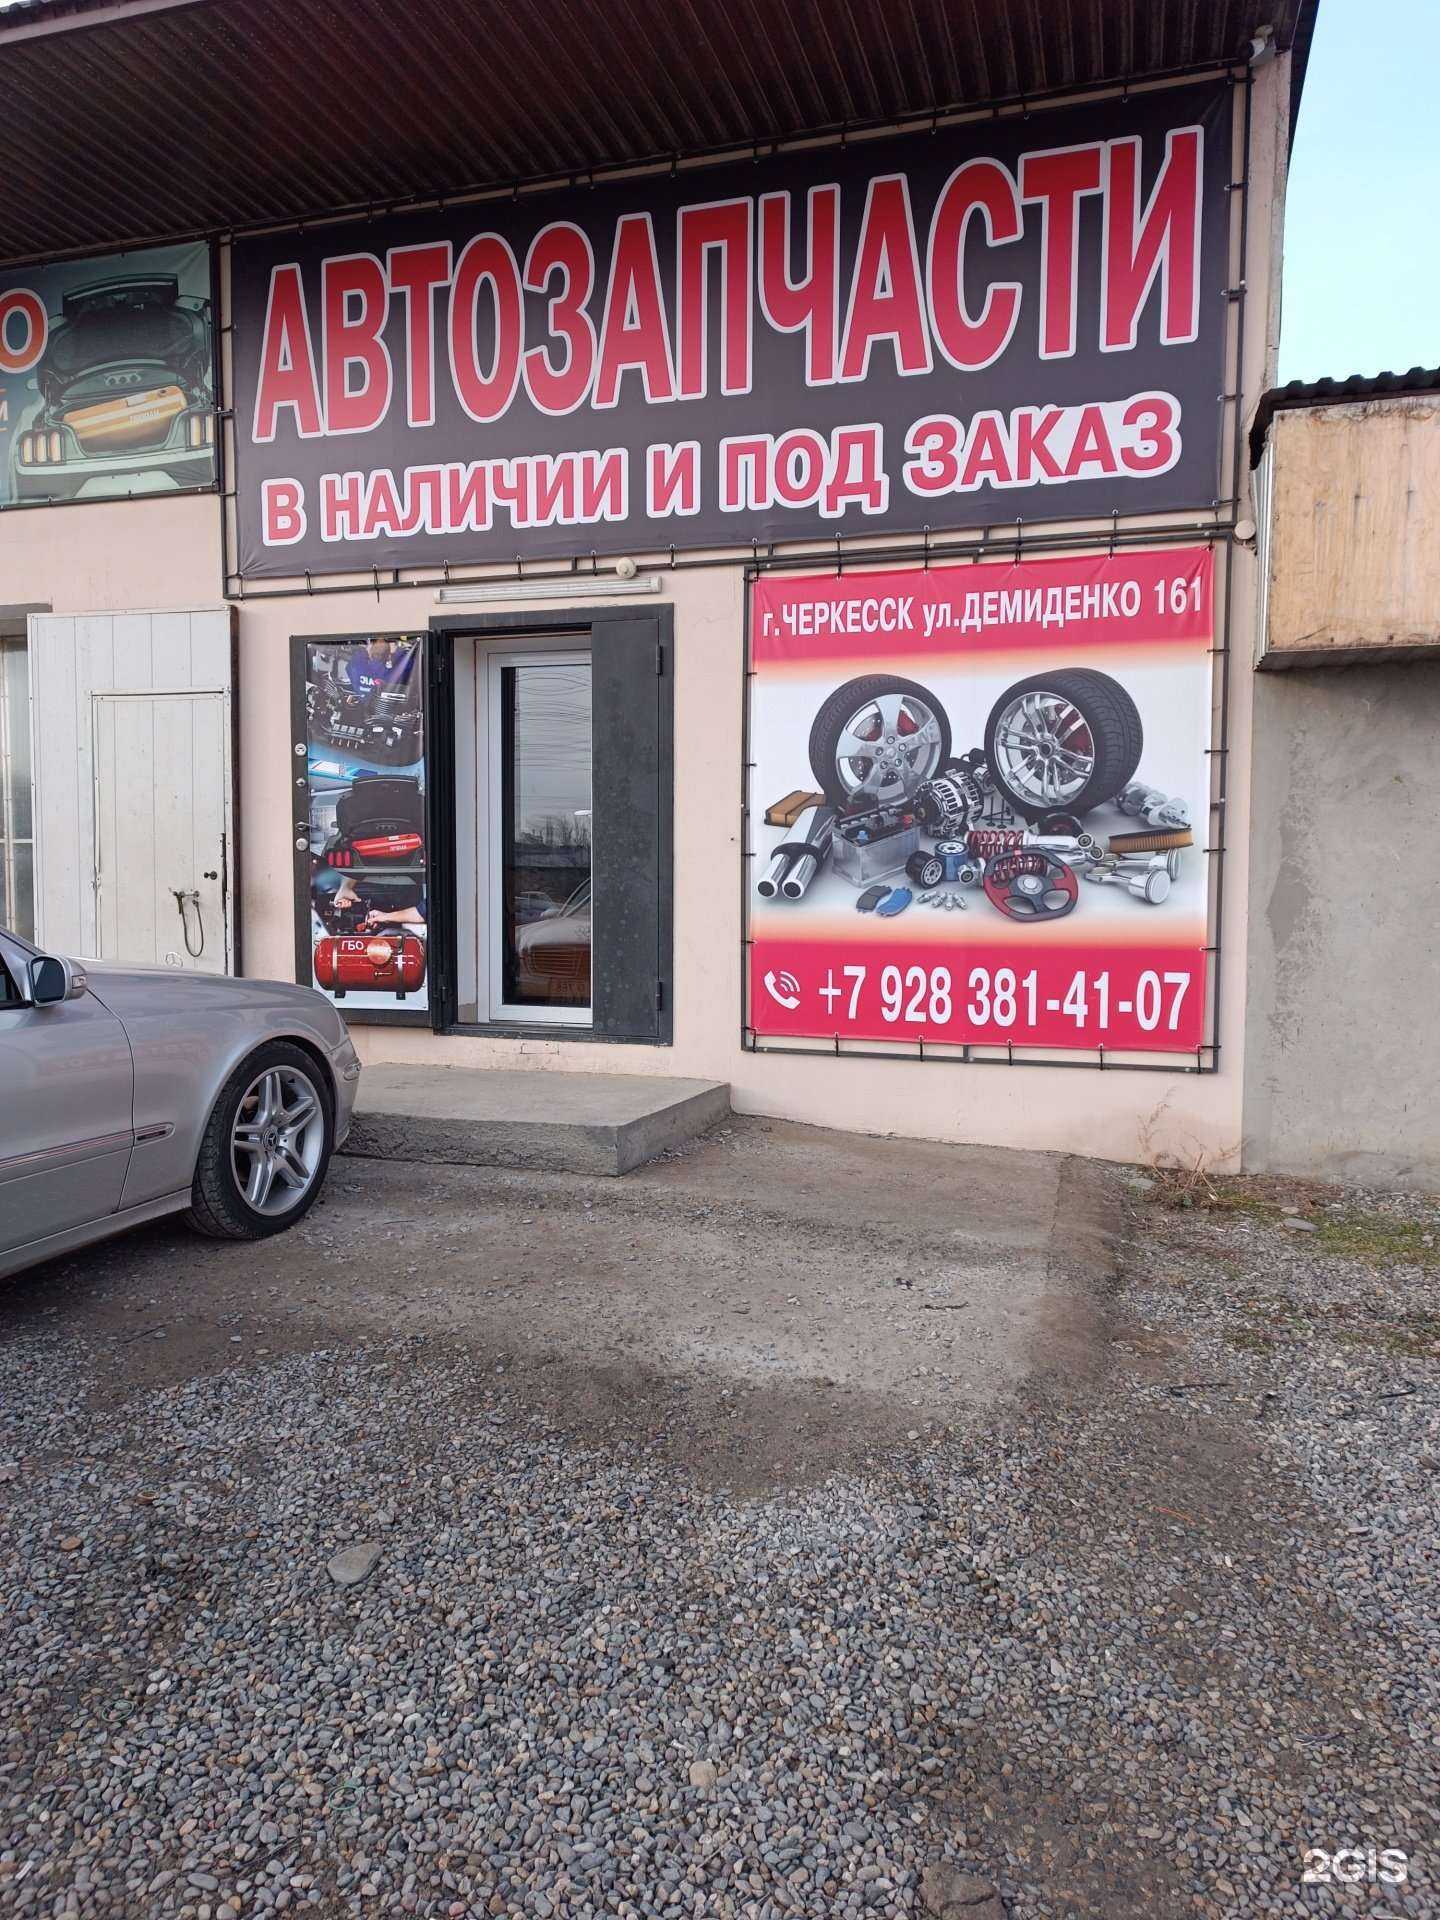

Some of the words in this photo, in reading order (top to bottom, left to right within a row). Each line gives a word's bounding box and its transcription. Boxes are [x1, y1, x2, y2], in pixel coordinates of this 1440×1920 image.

[252, 125, 1204, 443] АВТОЗАПЧАСТИ
[261, 477, 307, 546] В
[320, 448, 628, 542] НАЛИЧИИ
[646, 440, 700, 518] И
[719, 422, 889, 518] ПОД
[902, 390, 1182, 497] ЗАКАЗ
[1154, 576, 1201, 614] 161
[341, 940, 364, 951] ГБО
[819, 966, 866, 1020] +7
[880, 966, 952, 1024] 928
[967, 967, 1191, 1030] 381-41-07
